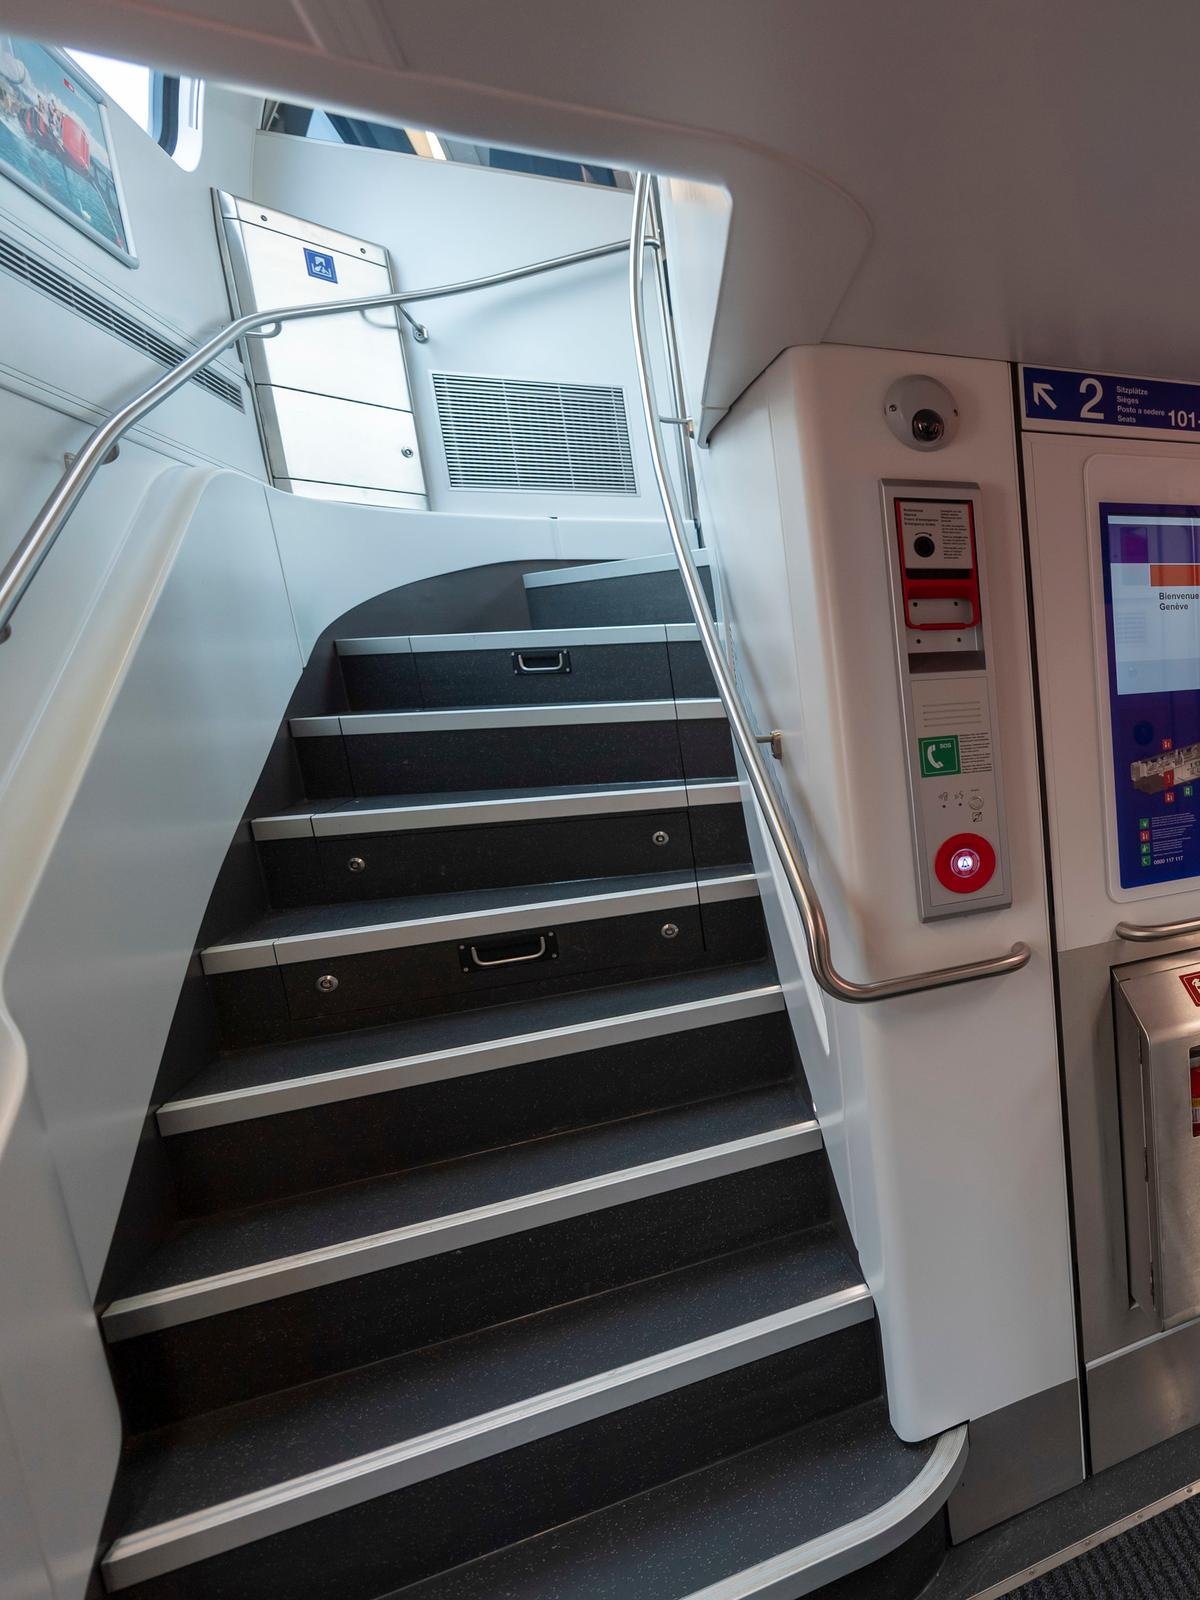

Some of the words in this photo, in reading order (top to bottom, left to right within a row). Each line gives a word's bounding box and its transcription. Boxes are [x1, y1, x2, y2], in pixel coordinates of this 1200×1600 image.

[1116, 386, 1148, 396] Sitzplätze
[1079, 378, 1104, 420] 2
[1117, 405, 1137, 415] Posto
[1143, 408, 1165, 417] sedere
[1117, 415, 1137, 424] Seats
[1159, 591, 1200, 601] Bienvenue
[1159, 602, 1189, 612] Genève
